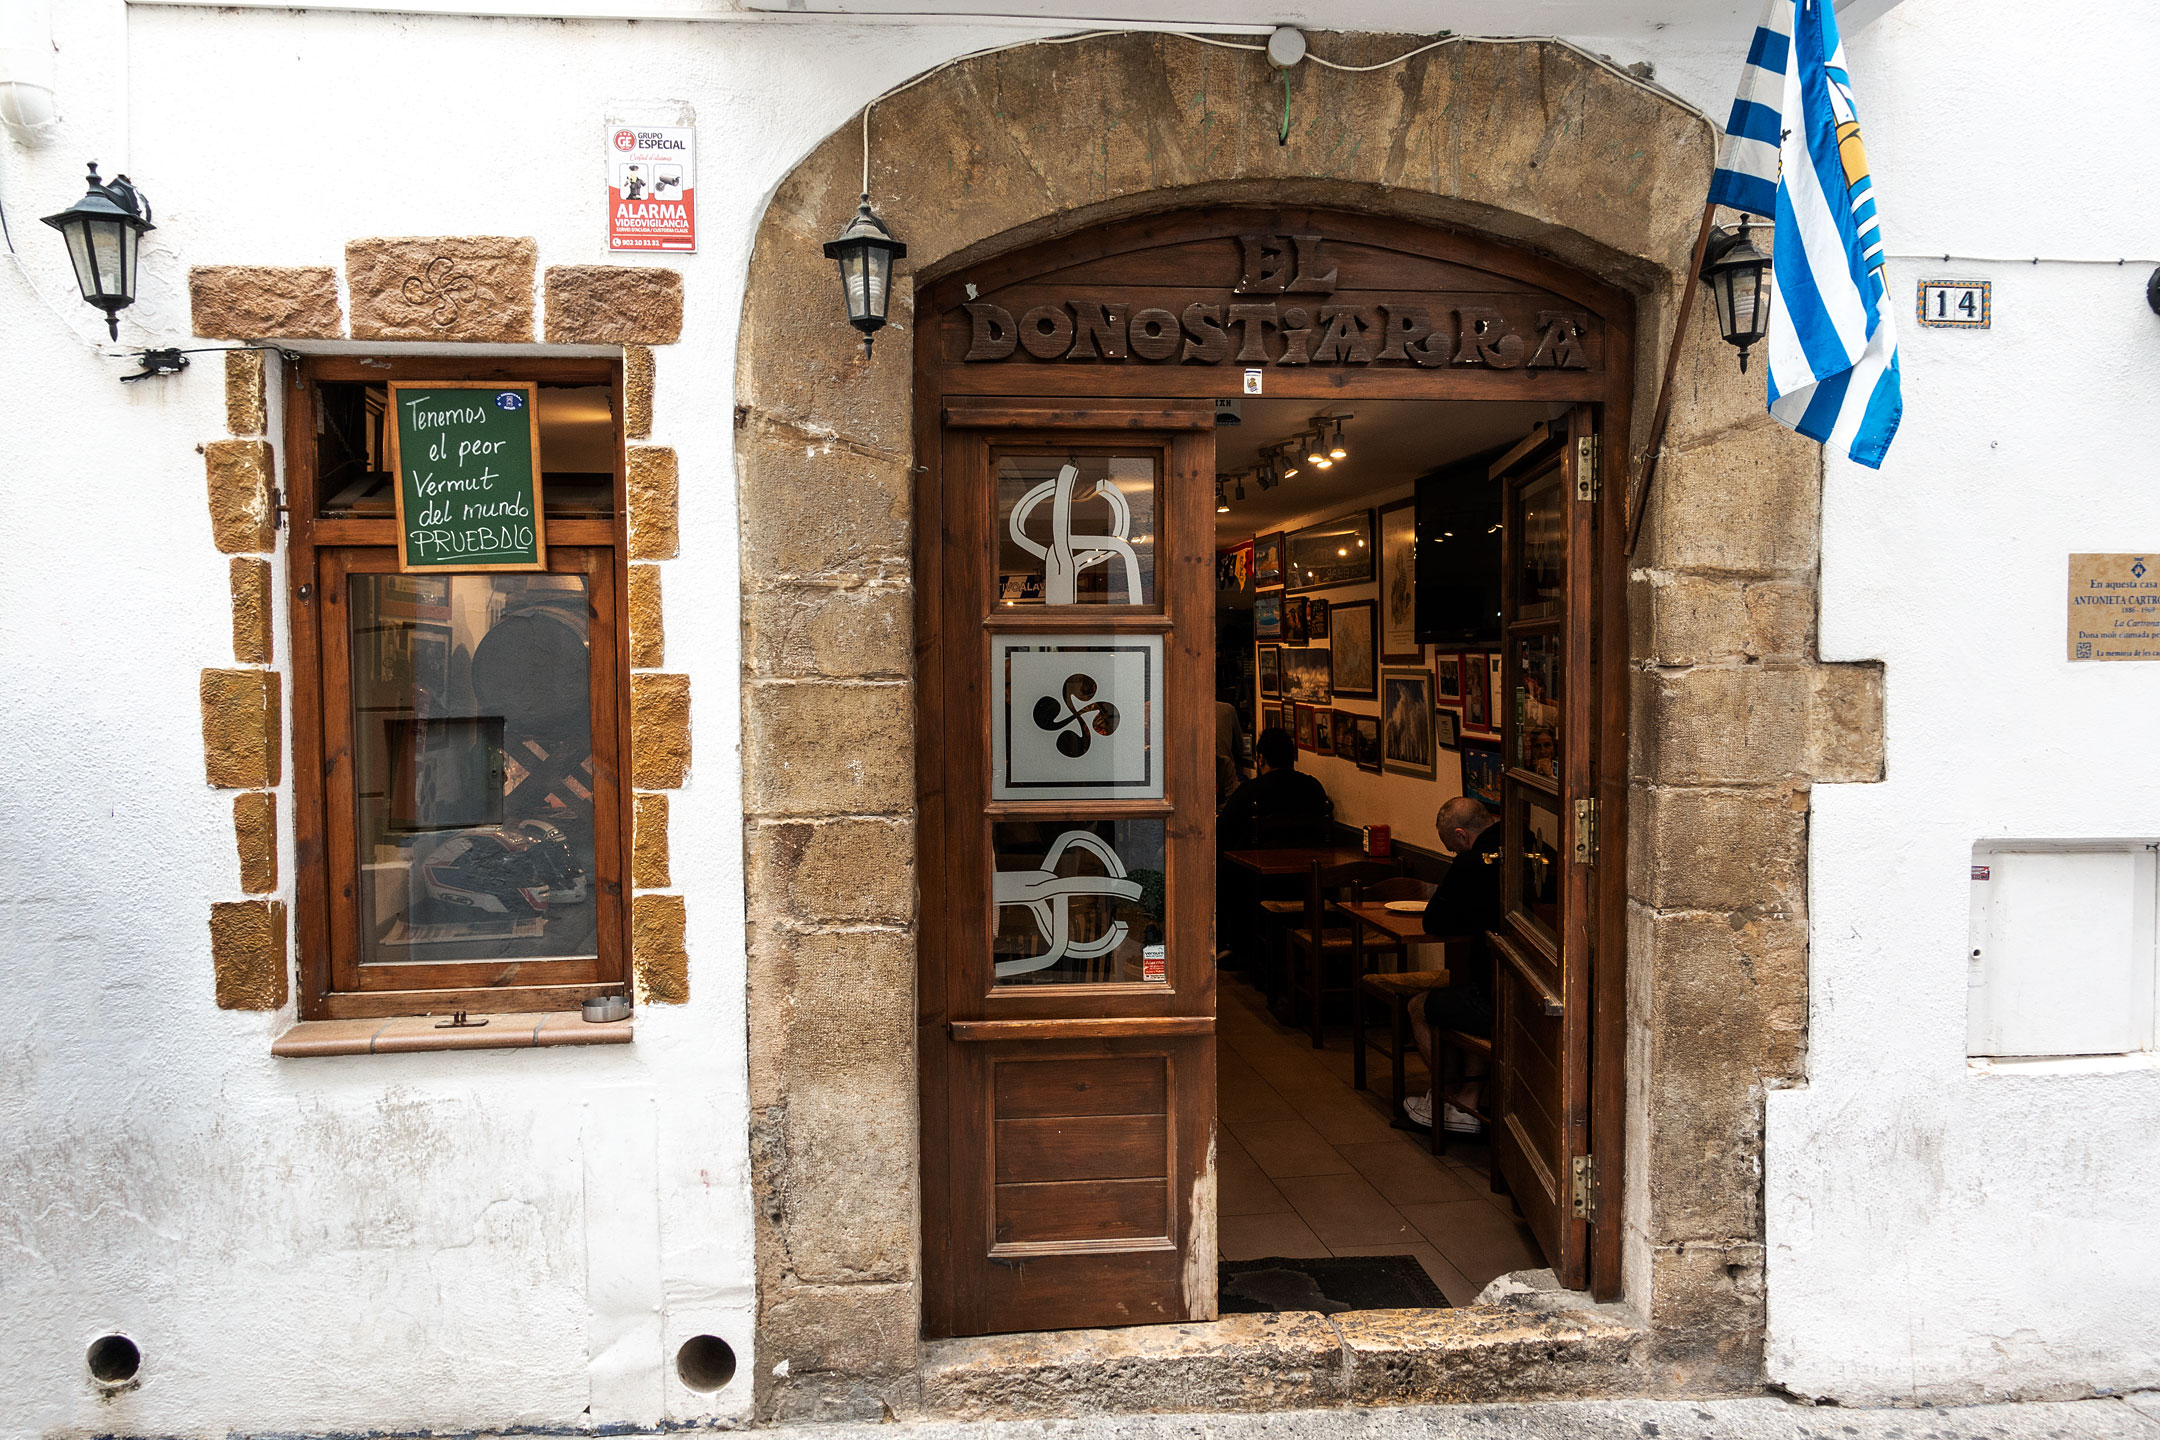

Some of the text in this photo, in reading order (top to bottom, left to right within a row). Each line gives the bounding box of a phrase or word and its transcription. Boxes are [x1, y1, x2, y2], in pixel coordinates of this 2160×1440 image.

[617, 136, 632, 147] GE
[638, 139, 686, 150] ESPECIAL
[617, 203, 687, 219] ALARMA
[614, 218, 689, 228] VIDEOVIGILANCIA
[1233, 234, 1338, 293] EL
[1936, 290, 1977, 318] 14
[406, 396, 486, 431] Tenemos
[429, 432, 507, 467] el peor
[412, 466, 499, 498] Vermut
[418, 491, 529, 527] del mundo
[2090, 579, 2158, 590] En aquesta casa
[2074, 595, 2126, 605] ANTONIETA
[2079, 630, 2099, 638] Dona
